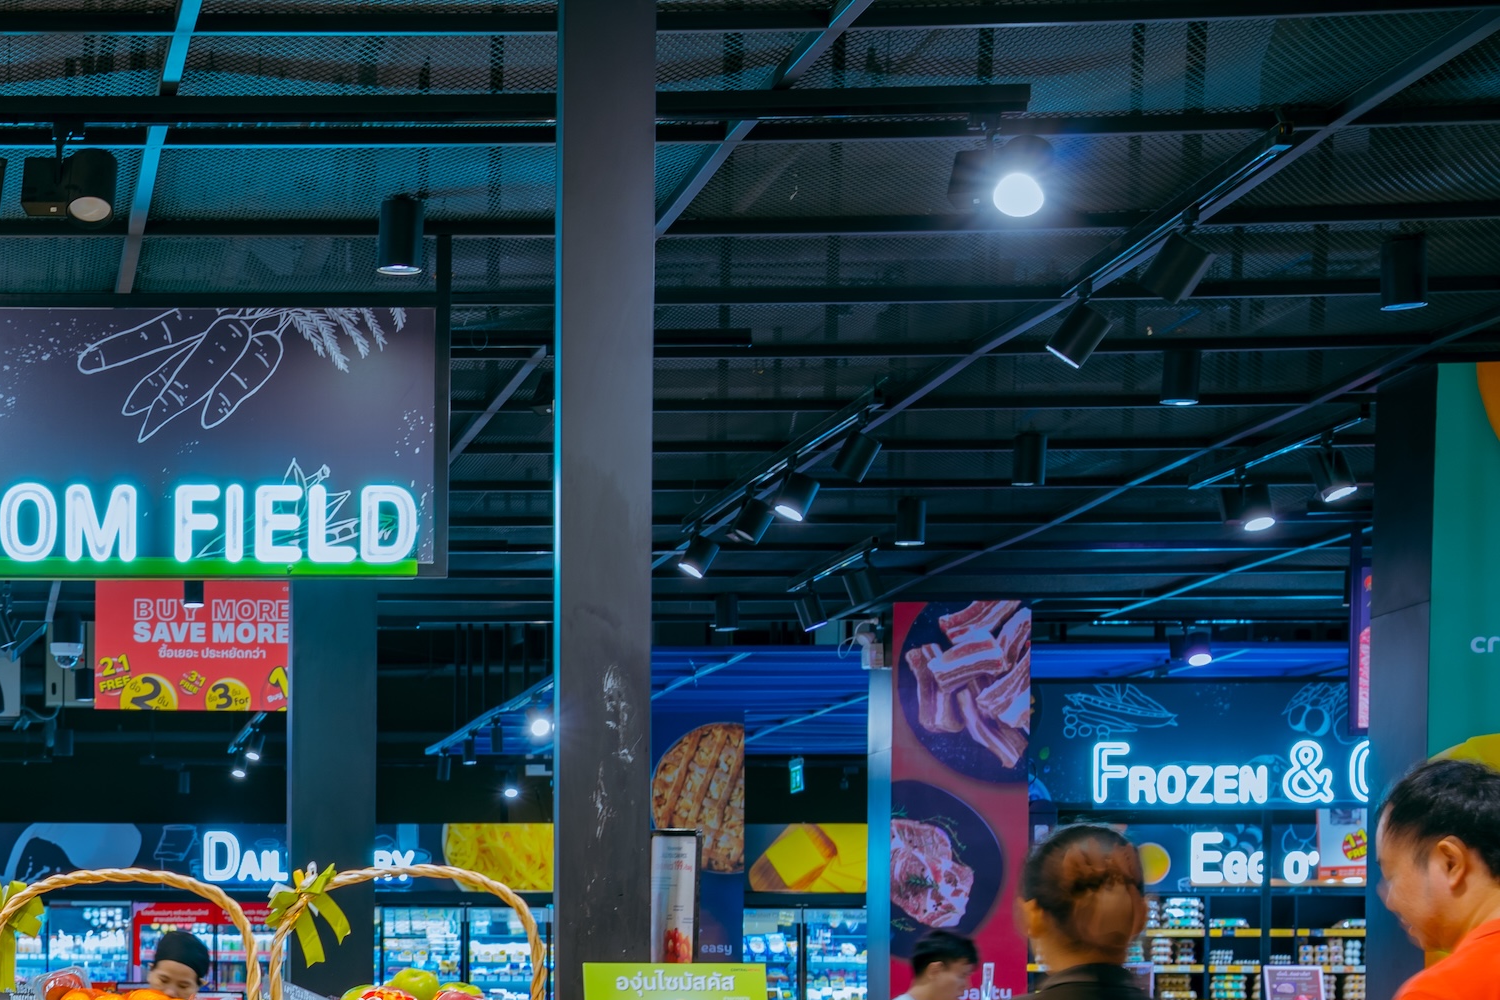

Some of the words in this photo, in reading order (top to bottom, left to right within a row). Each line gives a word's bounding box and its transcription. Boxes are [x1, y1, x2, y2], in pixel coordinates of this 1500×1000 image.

[174, 483, 419, 564] FIELD
[133, 598, 198, 621] BUY
[212, 599, 289, 622] MORE
[133, 622, 206, 643] SAVE
[212, 623, 289, 644] MORE
[158, 644, 199, 659] ซื้อเยอะ
[201, 647, 267, 659] ประหยัดกว่า
[99, 675, 131, 693] FREE
[131, 676, 163, 710] 2
[180, 680, 199, 694] FREE
[212, 684, 233, 709] 3
[1093, 741, 1268, 804] FROZEN
[1282, 740, 1335, 804] &
[203, 831, 288, 881] DAIL
[701, 943, 733, 956] easy
